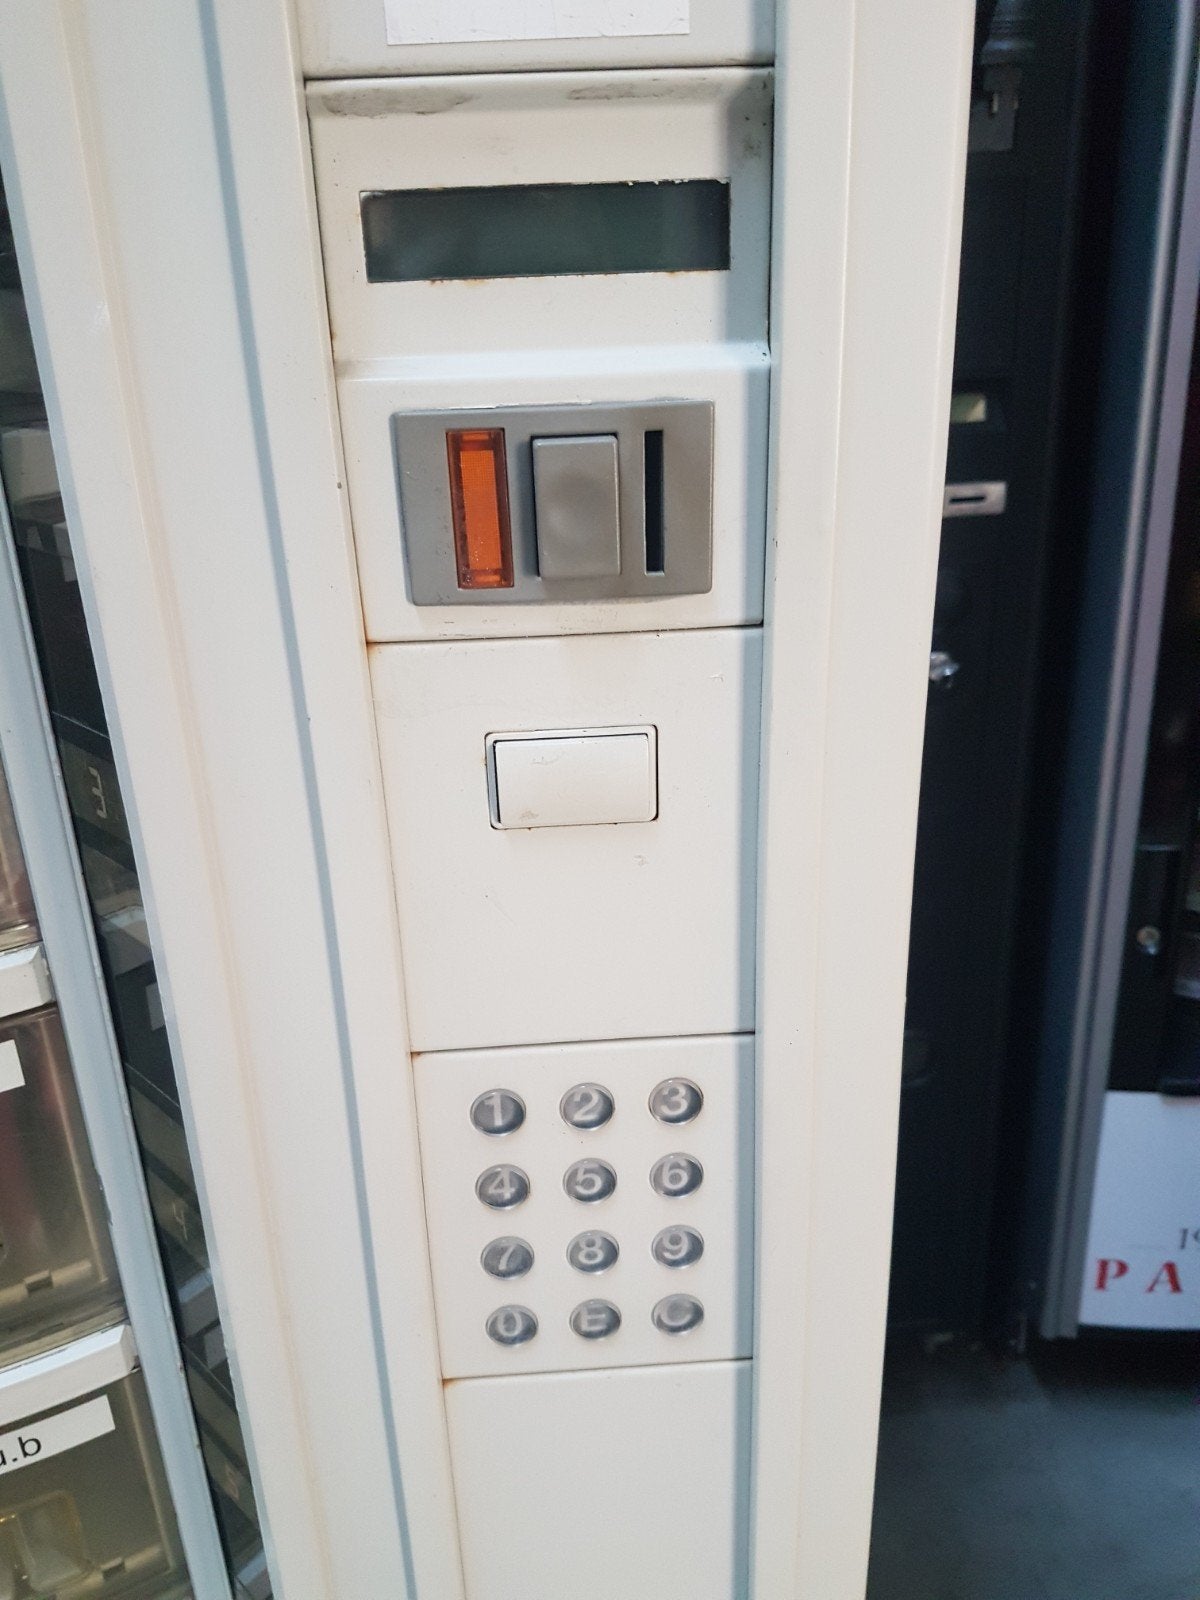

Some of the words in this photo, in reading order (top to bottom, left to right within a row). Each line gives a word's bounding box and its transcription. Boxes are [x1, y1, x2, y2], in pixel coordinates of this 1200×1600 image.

[484, 1090, 502, 1127] 1
[571, 1089, 600, 1121] 2
[659, 1083, 689, 1116] 3
[488, 1166, 516, 1201] 4
[574, 1163, 602, 1195] 5
[660, 1158, 690, 1191] 6
[492, 1238, 519, 1271] 7
[577, 1234, 605, 1264] 8
[660, 1230, 689, 1260] 9
[496, 1307, 523, 1337] 0
[580, 1303, 608, 1332] E
[660, 1297, 692, 1327] C
